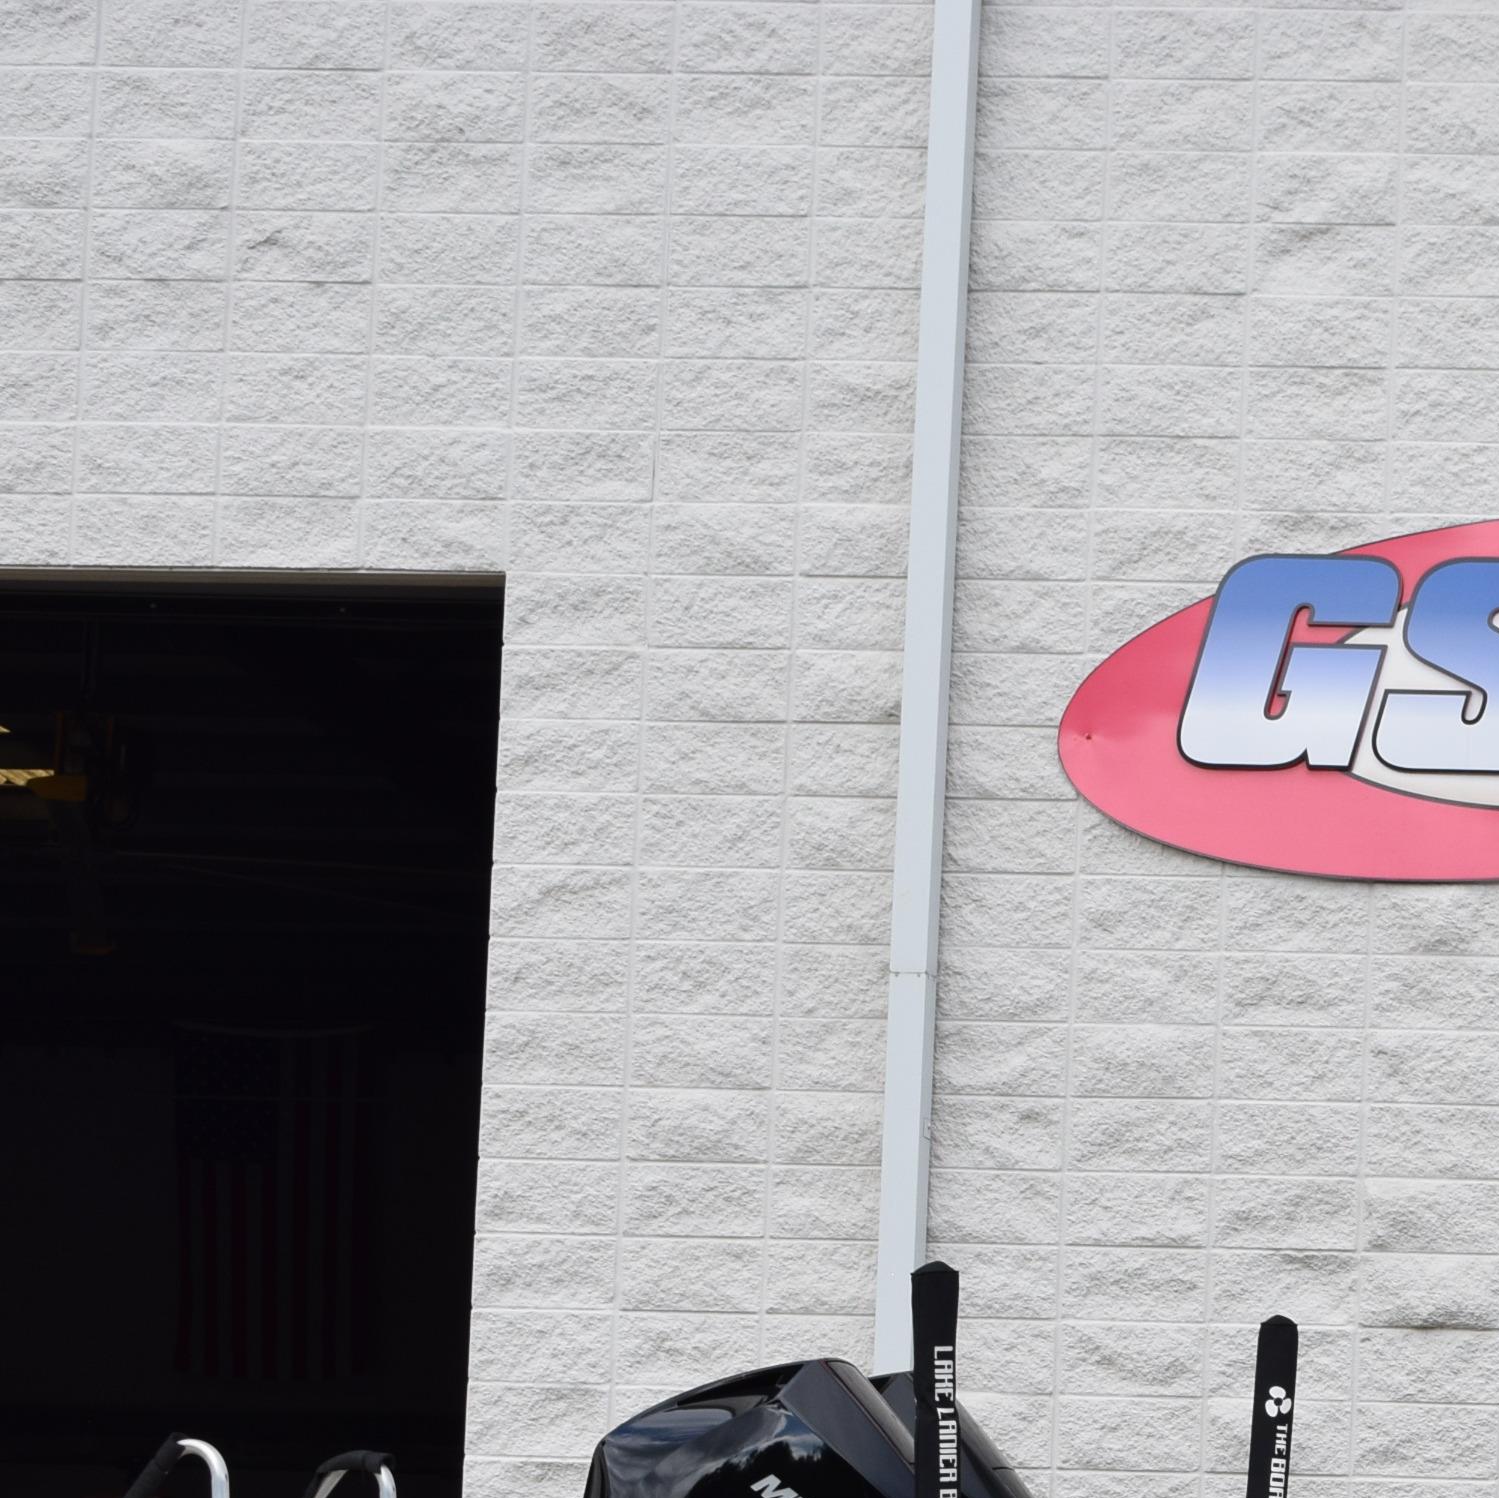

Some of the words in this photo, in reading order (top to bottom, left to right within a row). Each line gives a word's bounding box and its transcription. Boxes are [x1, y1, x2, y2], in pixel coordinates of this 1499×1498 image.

[934, 1345, 954, 1402] LAKE
[936, 1406, 958, 1483] LANIER
[1274, 1423, 1288, 1456] THE
